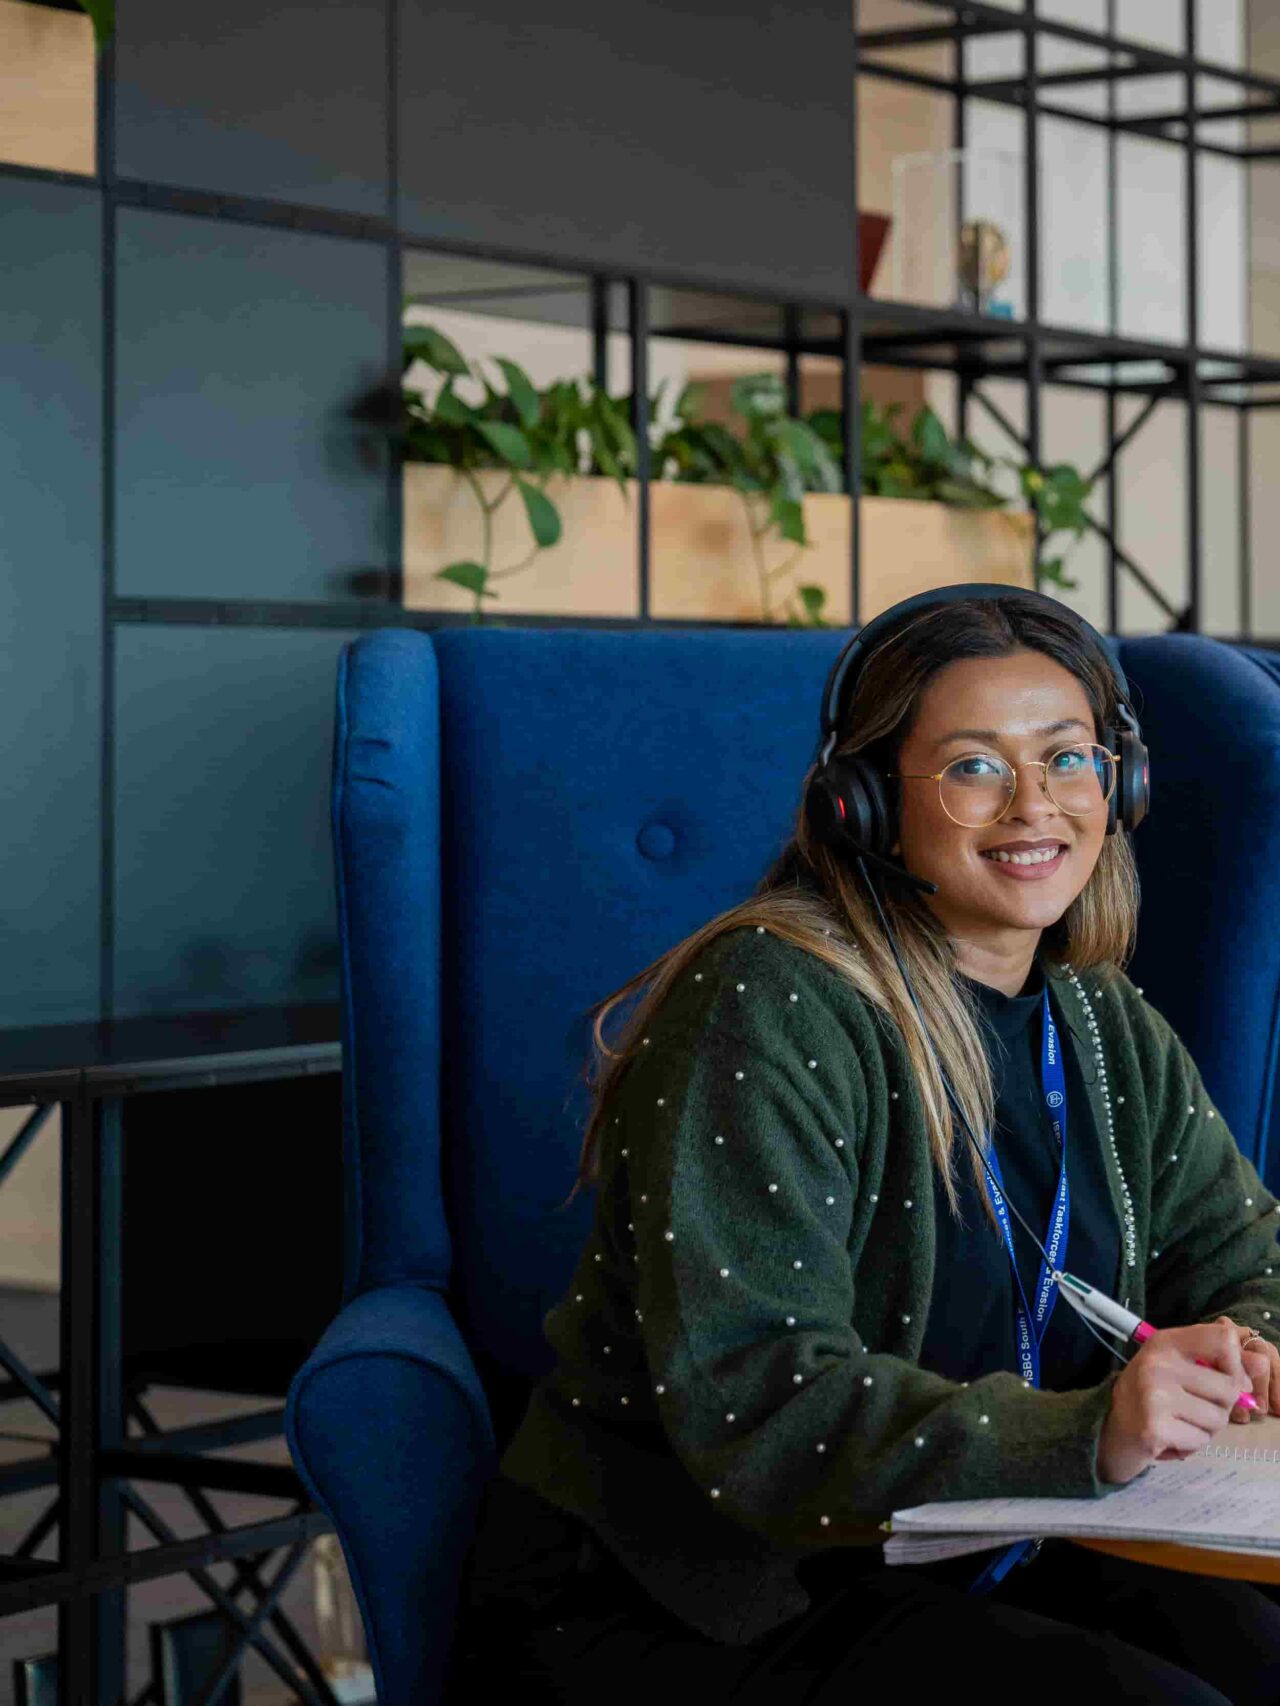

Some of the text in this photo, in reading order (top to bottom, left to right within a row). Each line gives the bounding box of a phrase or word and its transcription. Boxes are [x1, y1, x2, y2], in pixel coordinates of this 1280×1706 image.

[1048, 1025, 1056, 1065] Evasion
[1048, 1205, 1066, 1264] Taskforces
[1037, 1277, 1054, 1321] Evasion
[1019, 1316, 1030, 1350] South
